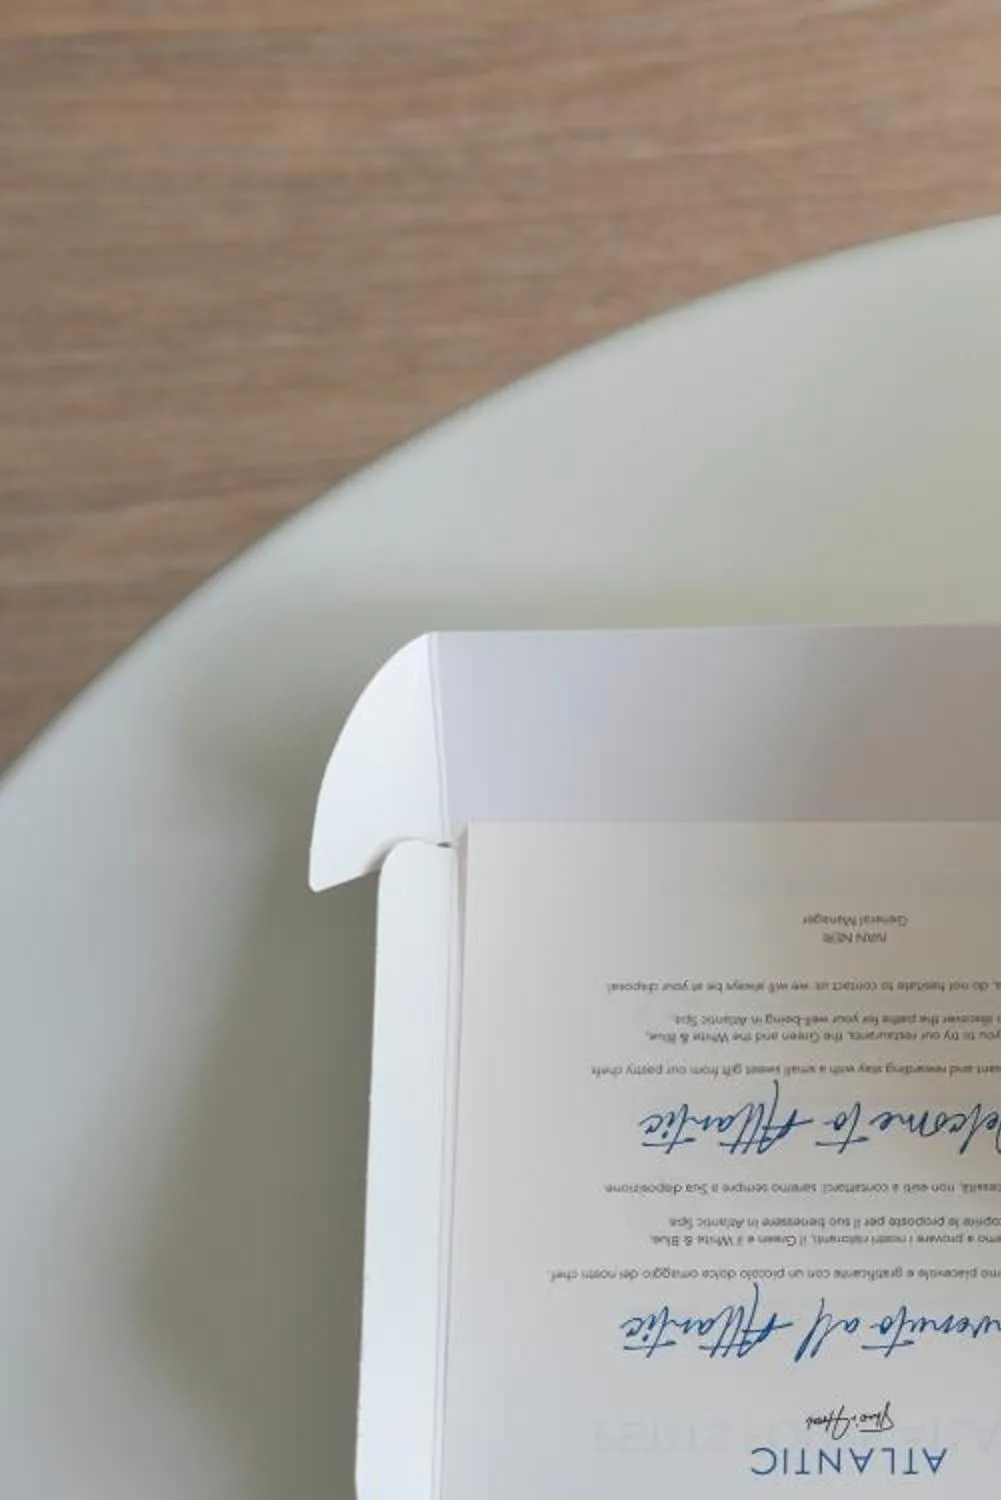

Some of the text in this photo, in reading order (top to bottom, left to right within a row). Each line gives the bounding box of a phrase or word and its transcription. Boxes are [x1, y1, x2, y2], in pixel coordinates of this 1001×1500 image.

[801, 913, 909, 927] General Manager
[661, 980, 687, 991] your
[691, 982, 703, 992] at
[706, 982, 723, 994] be
[725, 980, 765, 992] always
[768, 982, 789, 994] will
[790, 981, 810, 991] we
[832, 981, 877, 991] contact
[880, 981, 894, 991] to
[897, 981, 947, 992] hesitate
[949, 981, 969, 992] not
[971, 981, 989, 992] do
[700, 1016, 746, 1027] Atlantic
[750, 1016, 762, 1026] in
[832, 1011, 859, 1024] your
[862, 1015, 879, 1026] for
[882, 1014, 917, 1026] paths
[919, 1015, 939, 1027] the
[942, 1015, 993, 1026] discover
[679, 1032, 689, 1045] &
[692, 1032, 729, 1044] White
[732, 1032, 753, 1042] the
[754, 1031, 778, 1043] and
[781, 1031, 822, 1044] Green
[823, 1032, 843, 1043] the
[920, 1031, 941, 1041] our
[943, 1029, 959, 1041] try
[962, 1031, 976, 1041] to
[978, 1029, 1001, 1040] you
[625, 1062, 664, 1075] pastry
[665, 1065, 687, 1075] our
[689, 1065, 719, 1079] from
[721, 1063, 743, 1079] gift
[745, 1065, 781, 1076] sweet
[783, 1065, 816, 1077] small
[819, 1065, 826, 1073] a
[829, 1065, 855, 1076] with
[857, 1062, 884, 1074] stay
[885, 1062, 946, 1076] rewarding
[949, 1065, 972, 1078] and
[638, 1080, 814, 1155] Atlantic
[815, 1102, 869, 1155] to
[685, 1183, 709, 1196] Sua
[711, 1184, 719, 1193] a
[721, 1182, 769, 1193] sempre
[770, 1183, 817, 1194] saremo
[891, 1183, 900, 1193] a
[931, 1183, 955, 1192] non
[696, 1218, 745, 1230] Atlantic
[747, 1218, 759, 1229] in
[761, 1217, 826, 1229] benessere
[853, 1219, 861, 1229] il
[864, 1216, 886, 1227] per
[888, 1216, 945, 1228] proposte
[947, 1217, 960, 1229] le
[682, 1235, 693, 1248] &
[695, 1234, 733, 1247] White
[736, 1236, 744, 1246] il
[747, 1235, 755, 1244] e
[757, 1235, 797, 1247] Green
[799, 1235, 807, 1246] il
[871, 1235, 907, 1246] nostri
[909, 1235, 913, 1246] i
[915, 1233, 963, 1247] provare
[966, 1235, 974, 1243] a
[581, 1269, 617, 1280] nostri
[619, 1269, 641, 1281] dei
[641, 1265, 699, 1280] omaggio
[701, 1267, 737, 1281] dolce
[739, 1267, 785, 1281] piccolo
[787, 1269, 805, 1279] un
[807, 1269, 831, 1279] con
[833, 1265, 903, 1282] gratificante
[906, 1269, 915, 1278] e
[917, 1267, 979, 1281] piacevole
[619, 1283, 793, 1359] Atlantic
[749, 1446, 949, 1477] ATLANTIC
